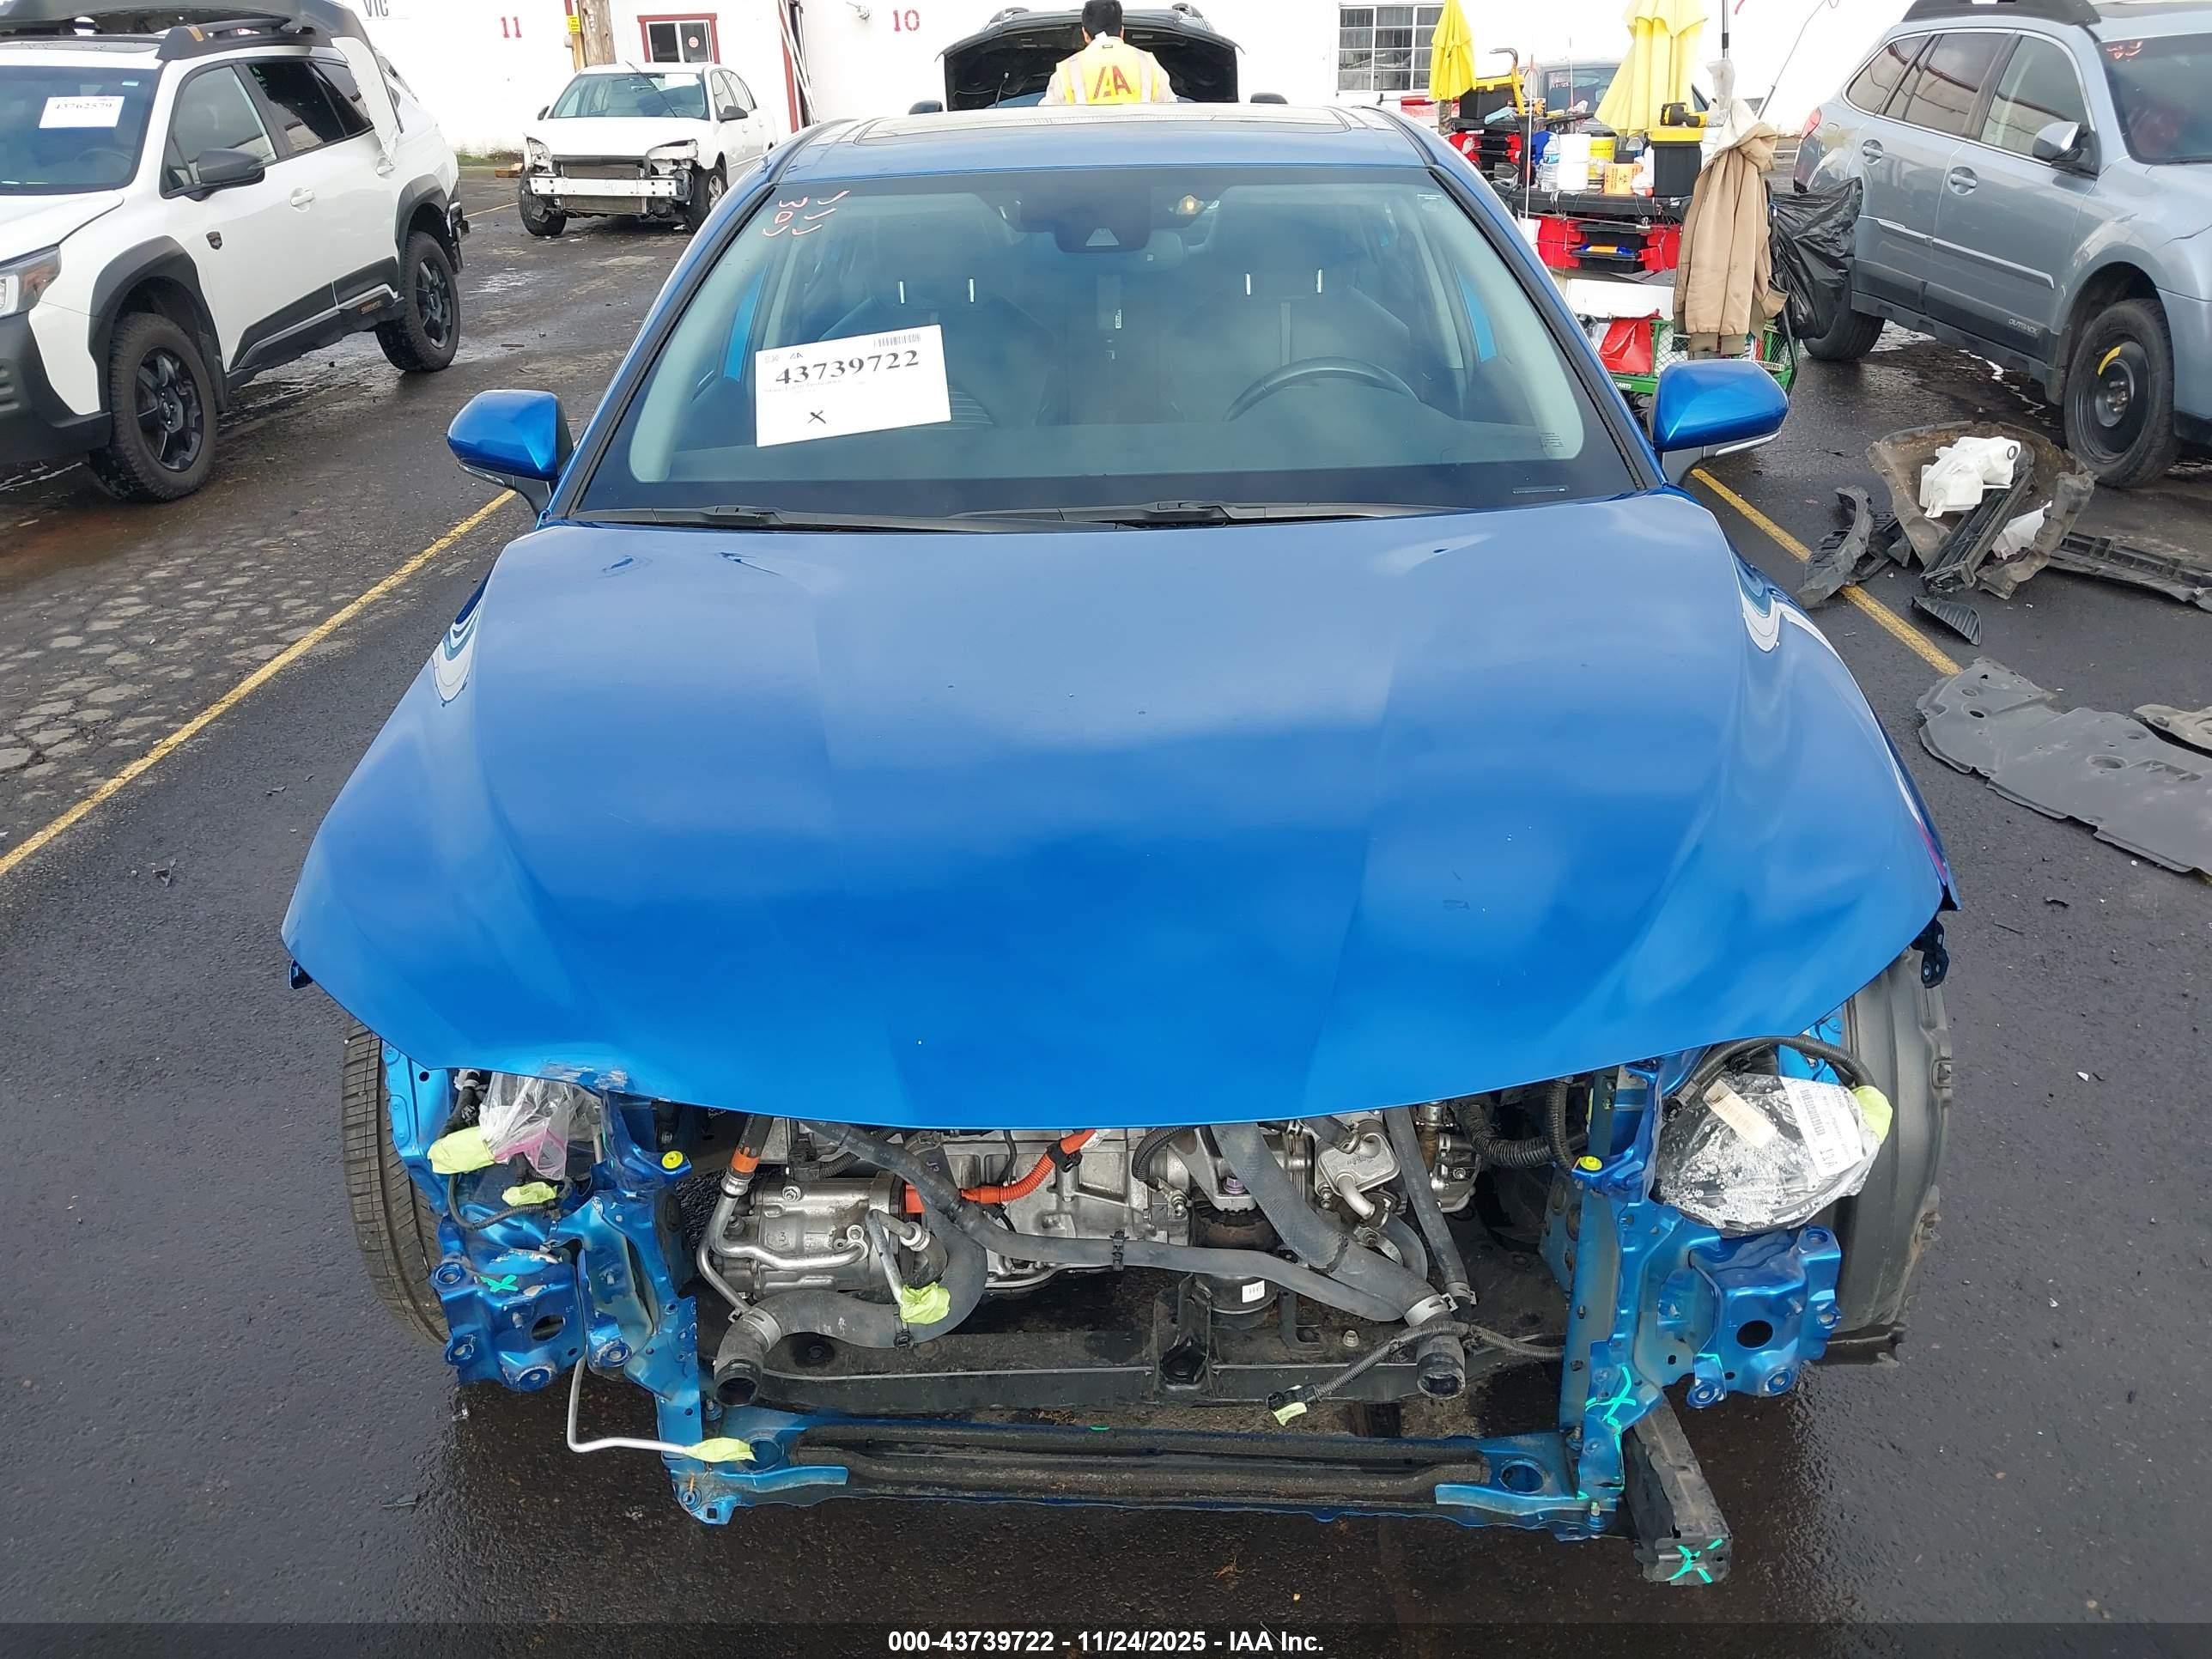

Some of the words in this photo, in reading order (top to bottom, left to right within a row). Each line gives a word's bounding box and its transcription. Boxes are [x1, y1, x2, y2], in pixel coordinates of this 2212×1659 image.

[501, 16, 522, 38] 11
[892, 9, 921, 32] 10
[2008, 318, 2039, 335] OUTBACK
[775, 349, 920, 384] 43739722
